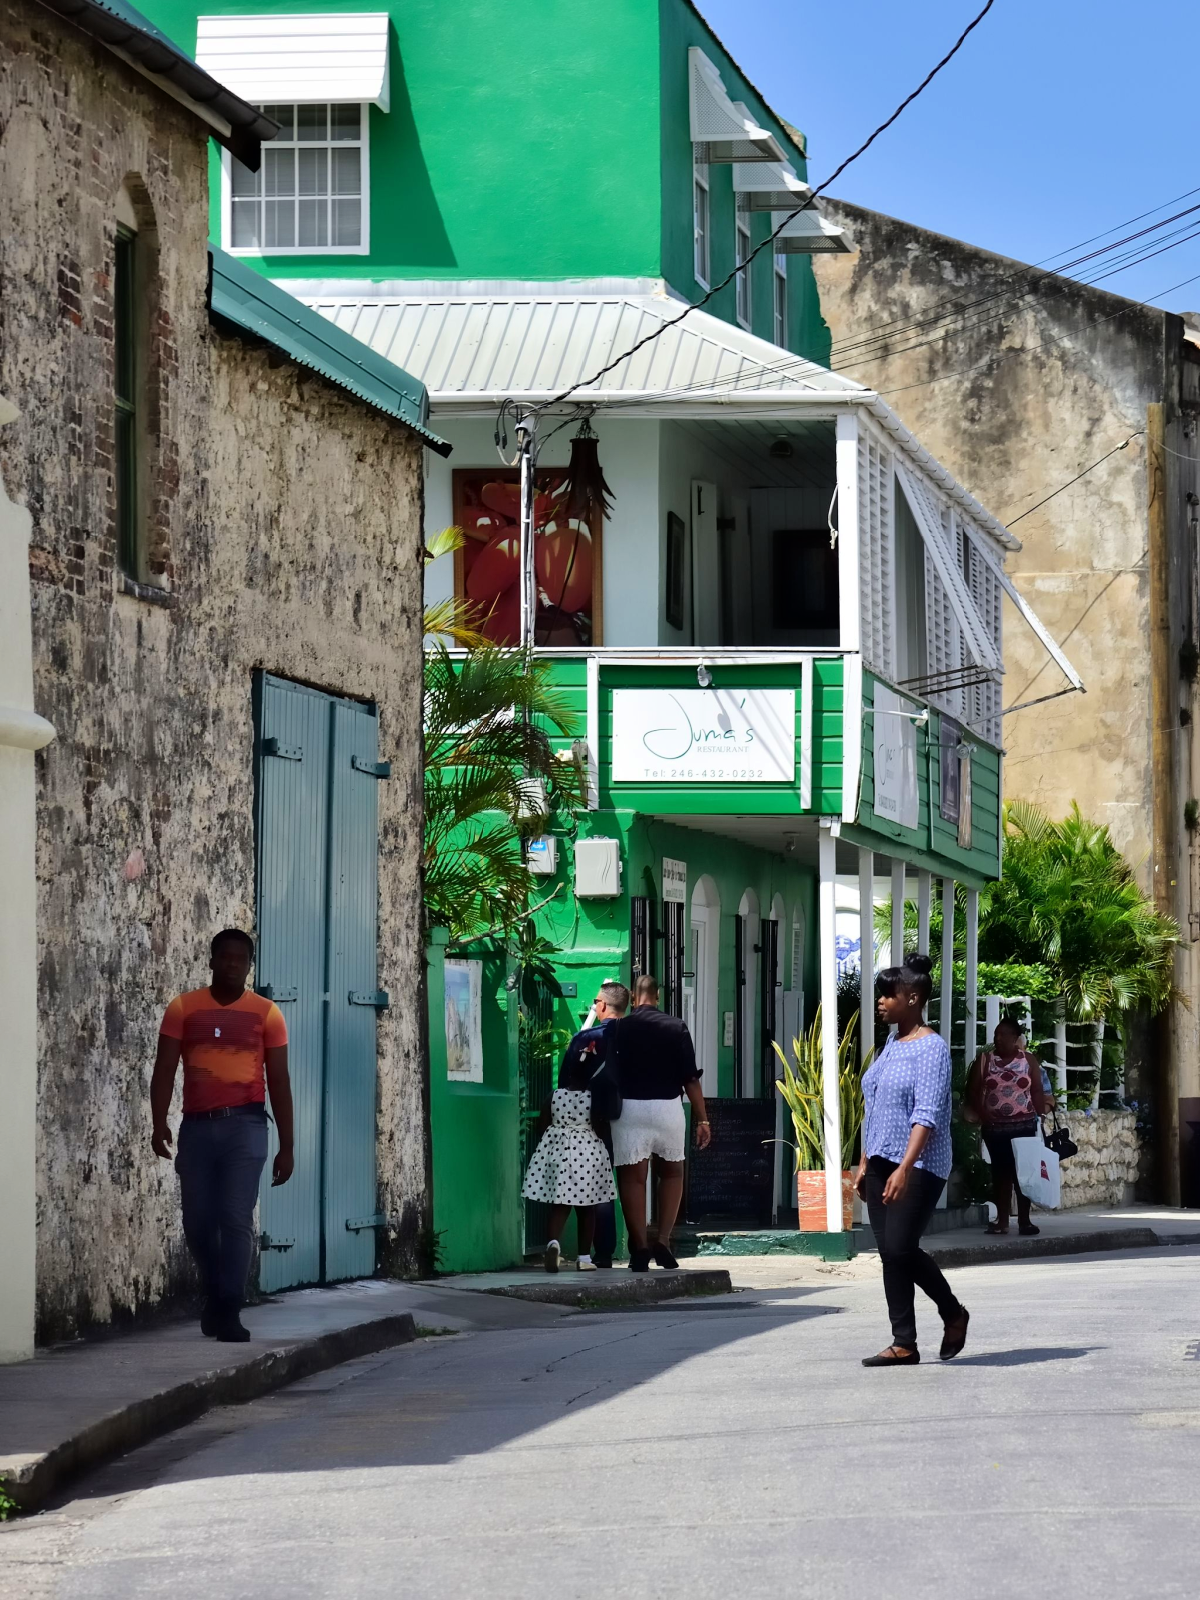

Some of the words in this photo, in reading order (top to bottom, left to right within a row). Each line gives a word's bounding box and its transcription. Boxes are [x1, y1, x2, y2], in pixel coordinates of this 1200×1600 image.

[643, 693, 754, 760] Juma's
[696, 745, 750, 753] RESTAURANT
[644, 769, 667, 778] Tel:
[670, 769, 764, 778] 246-432-0232
